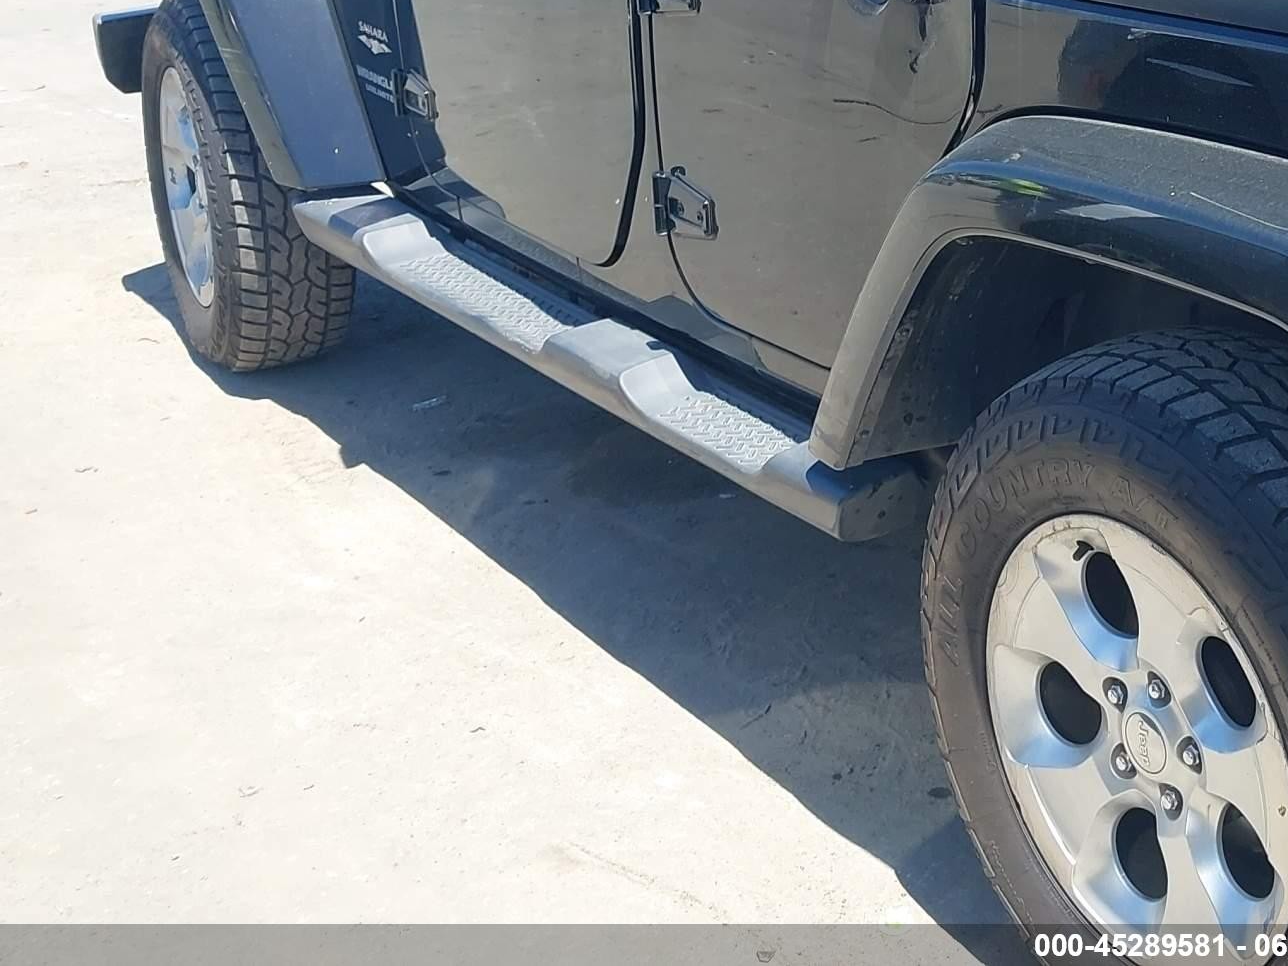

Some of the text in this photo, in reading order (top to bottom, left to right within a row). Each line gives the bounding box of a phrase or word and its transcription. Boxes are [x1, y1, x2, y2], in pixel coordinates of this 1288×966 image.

[358, 20, 388, 42] SAHARA
[356, 65, 393, 91] WRANGL
[958, 458, 1095, 559] COUNTRY
[1137, 720, 1150, 766] Jeep
